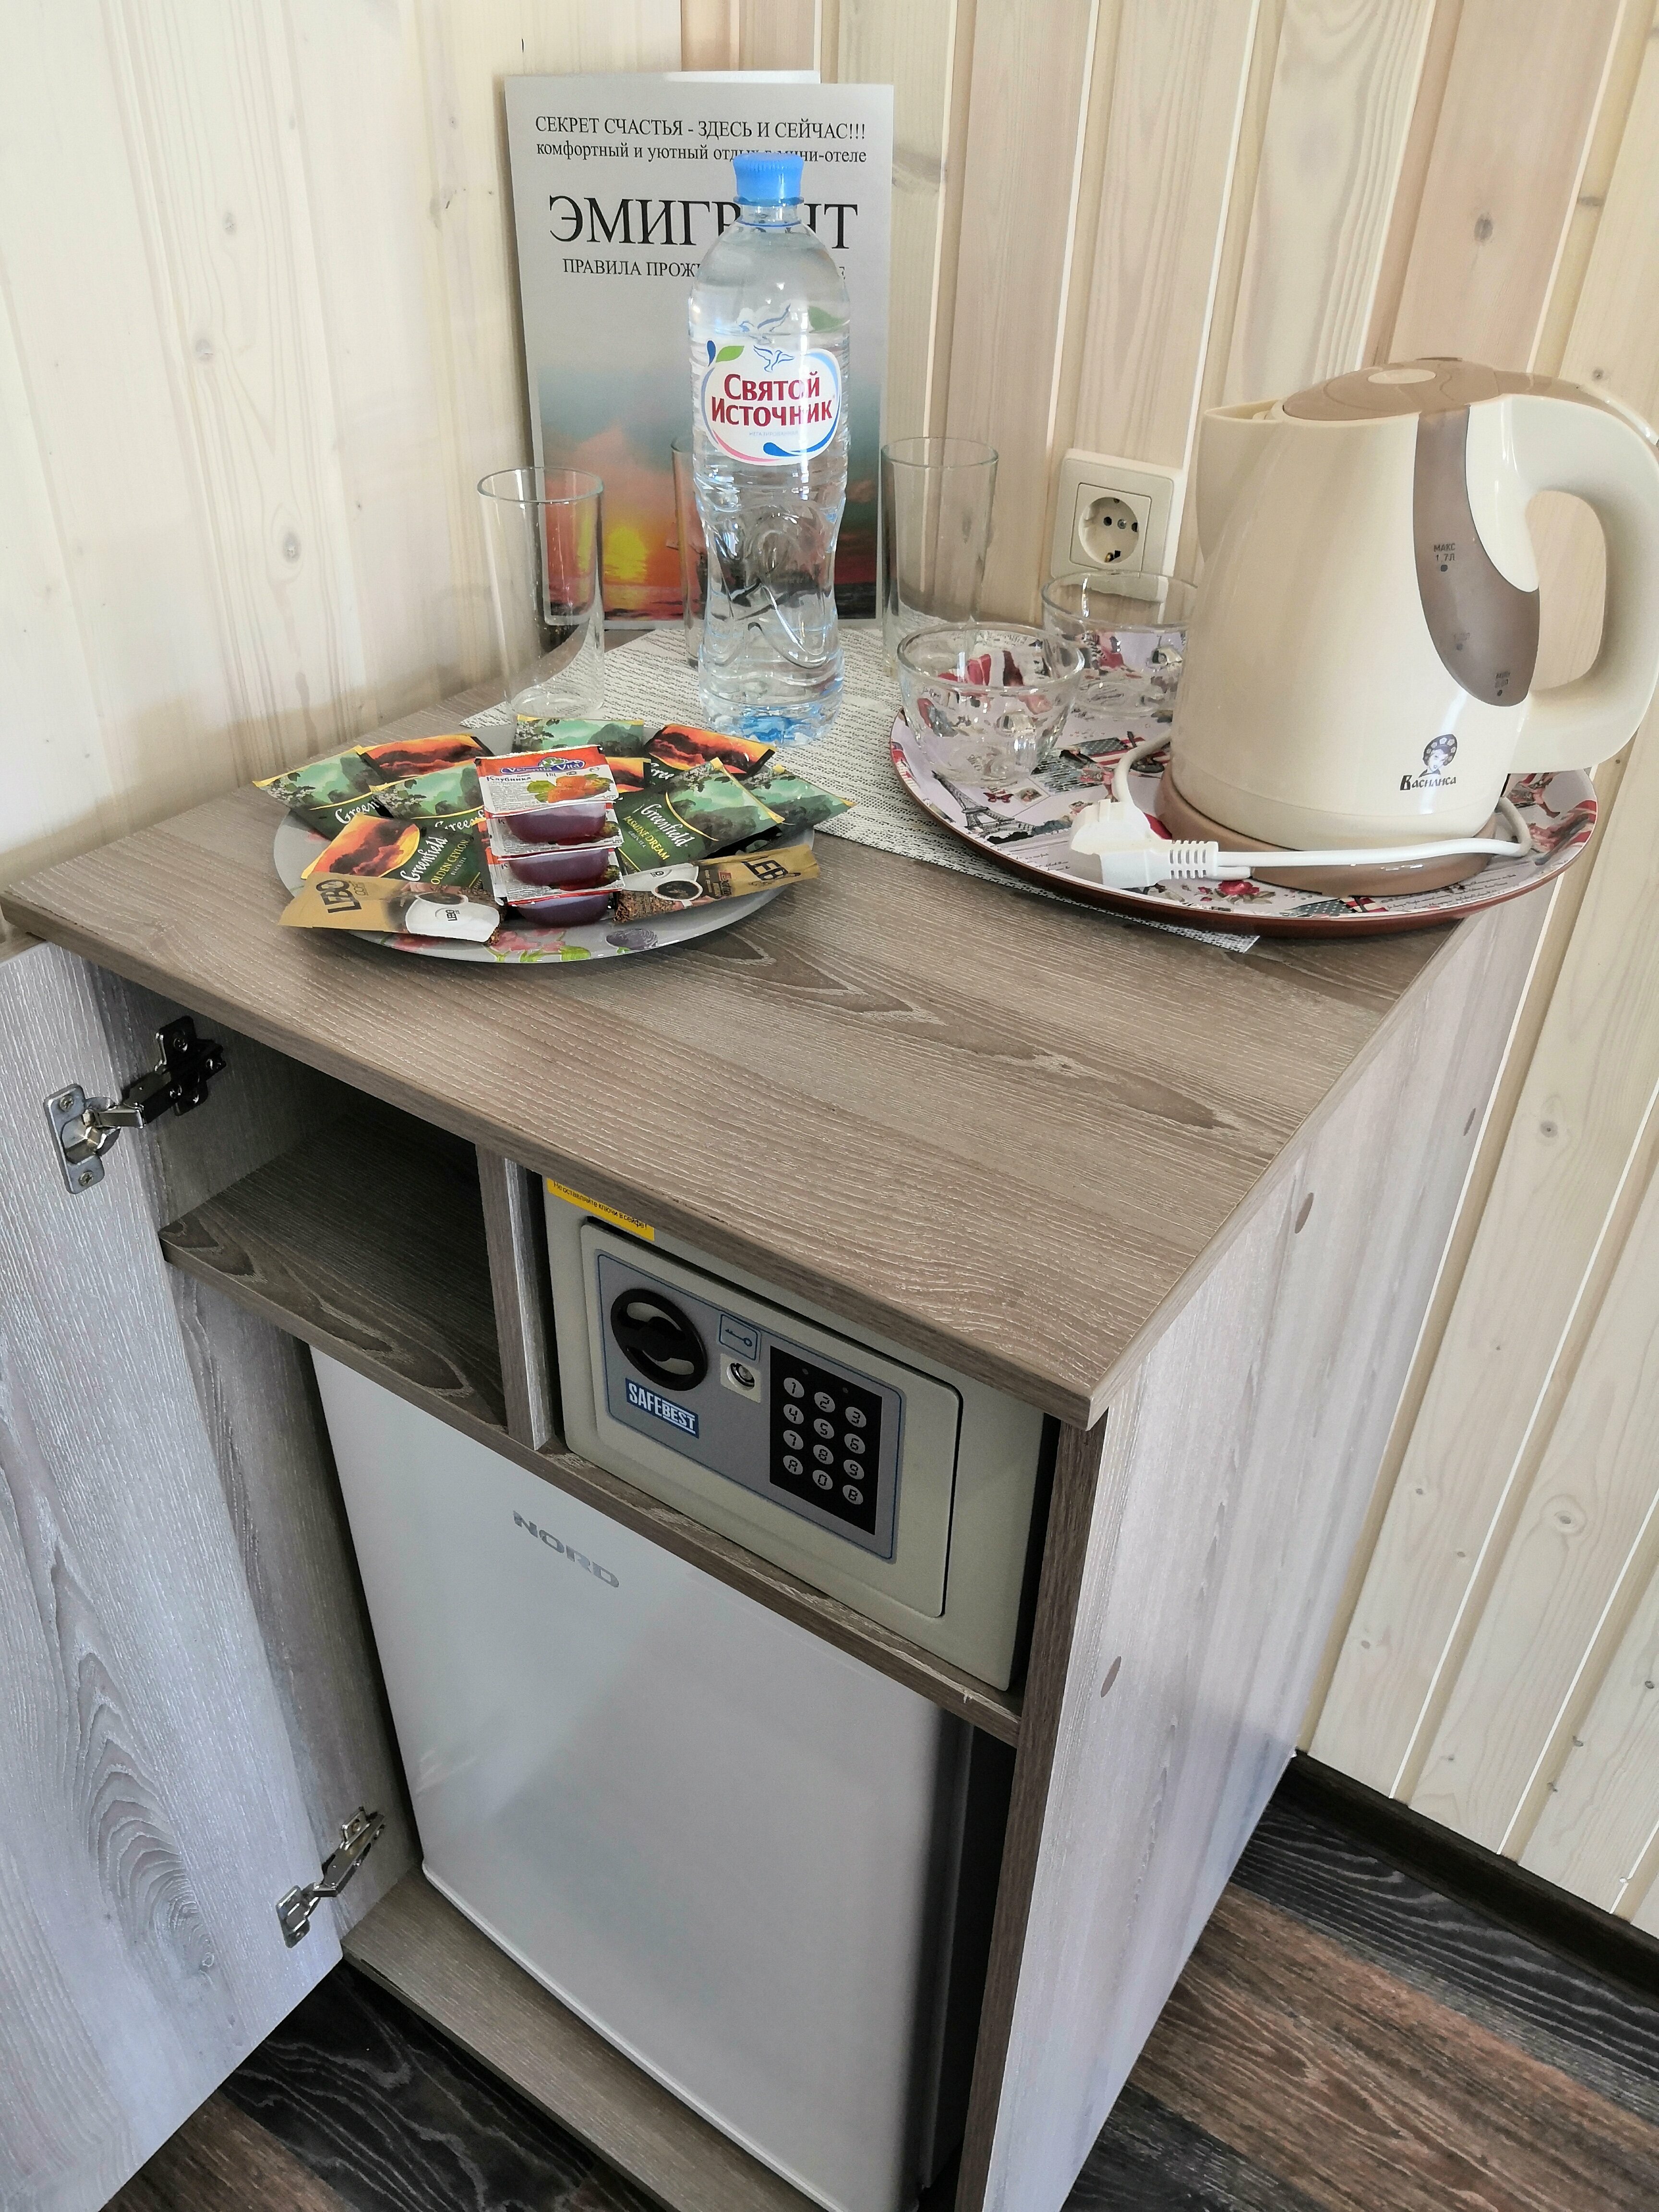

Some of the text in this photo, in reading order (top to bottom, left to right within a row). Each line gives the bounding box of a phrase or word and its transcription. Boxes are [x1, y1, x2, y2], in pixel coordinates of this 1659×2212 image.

[535, 116, 600, 134] СЕКРЕТ
[604, 118, 684, 135] СЧАСТЬЯ
[698, 120, 752, 140] ЗДЕСЬ
[757, 122, 770, 138] И
[775, 118, 866, 139] СЕЙЧАС!!!
[536, 140, 629, 160] комфортный
[634, 147, 643, 157] и
[648, 144, 709, 162] уютный
[713, 148, 760, 162] отд
[563, 258, 642, 276] ПРАВИЛА
[1433, 543, 1455, 553] МАКС
[623, 816, 670, 860] JASMINE DREAM
[640, 804, 696, 847] Greenfield
[400, 836, 448, 882] Greenfield
[431, 839, 469, 885] OLDEN CEYLON
[553, 1180, 562, 1190] Не
[563, 1188, 598, 1207] оставляйте
[599, 1203, 618, 1217] ключи
[628, 1382, 696, 1430] SAFEBEST
[792, 1382, 861, 1424] 1 2 3
[789, 1407, 859, 1451] 4 5 6
[790, 1433, 859, 1476] 7 8 9
[817, 1474, 828, 1487] 0
[513, 1510, 619, 1588] NORD
